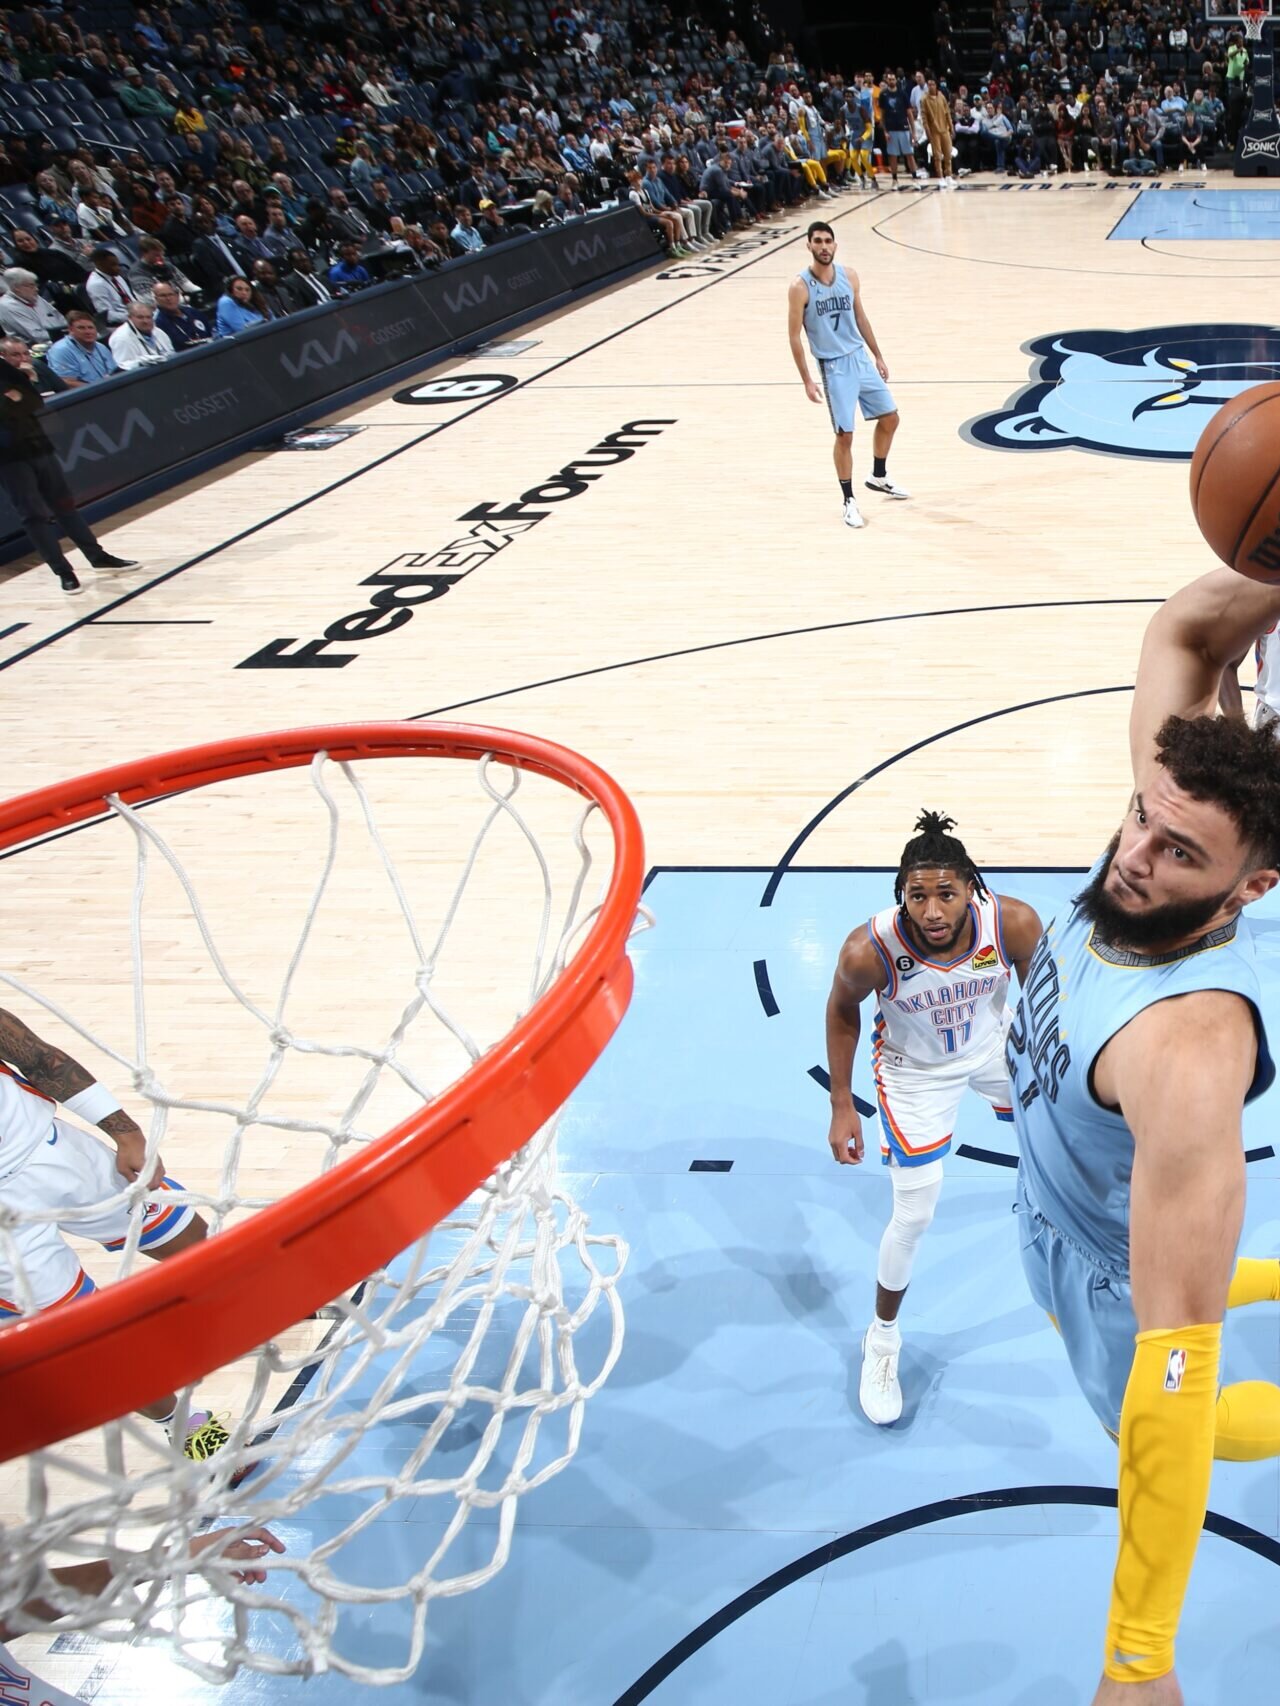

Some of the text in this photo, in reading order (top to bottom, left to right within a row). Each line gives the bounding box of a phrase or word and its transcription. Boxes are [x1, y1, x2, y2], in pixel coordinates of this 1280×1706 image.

[1247, 141, 1276, 151] SONIC
[815, 294, 851, 316] GRIZZLIES
[371, 318, 417, 346] GOSSETT
[830, 313, 840, 331] 7
[173, 387, 240, 425] GOSSETT
[233, 419, 679, 669] FedExForum
[901, 958, 910, 969] 6
[893, 975, 997, 1014] OKLAHOM
[930, 998, 978, 1027] CITY
